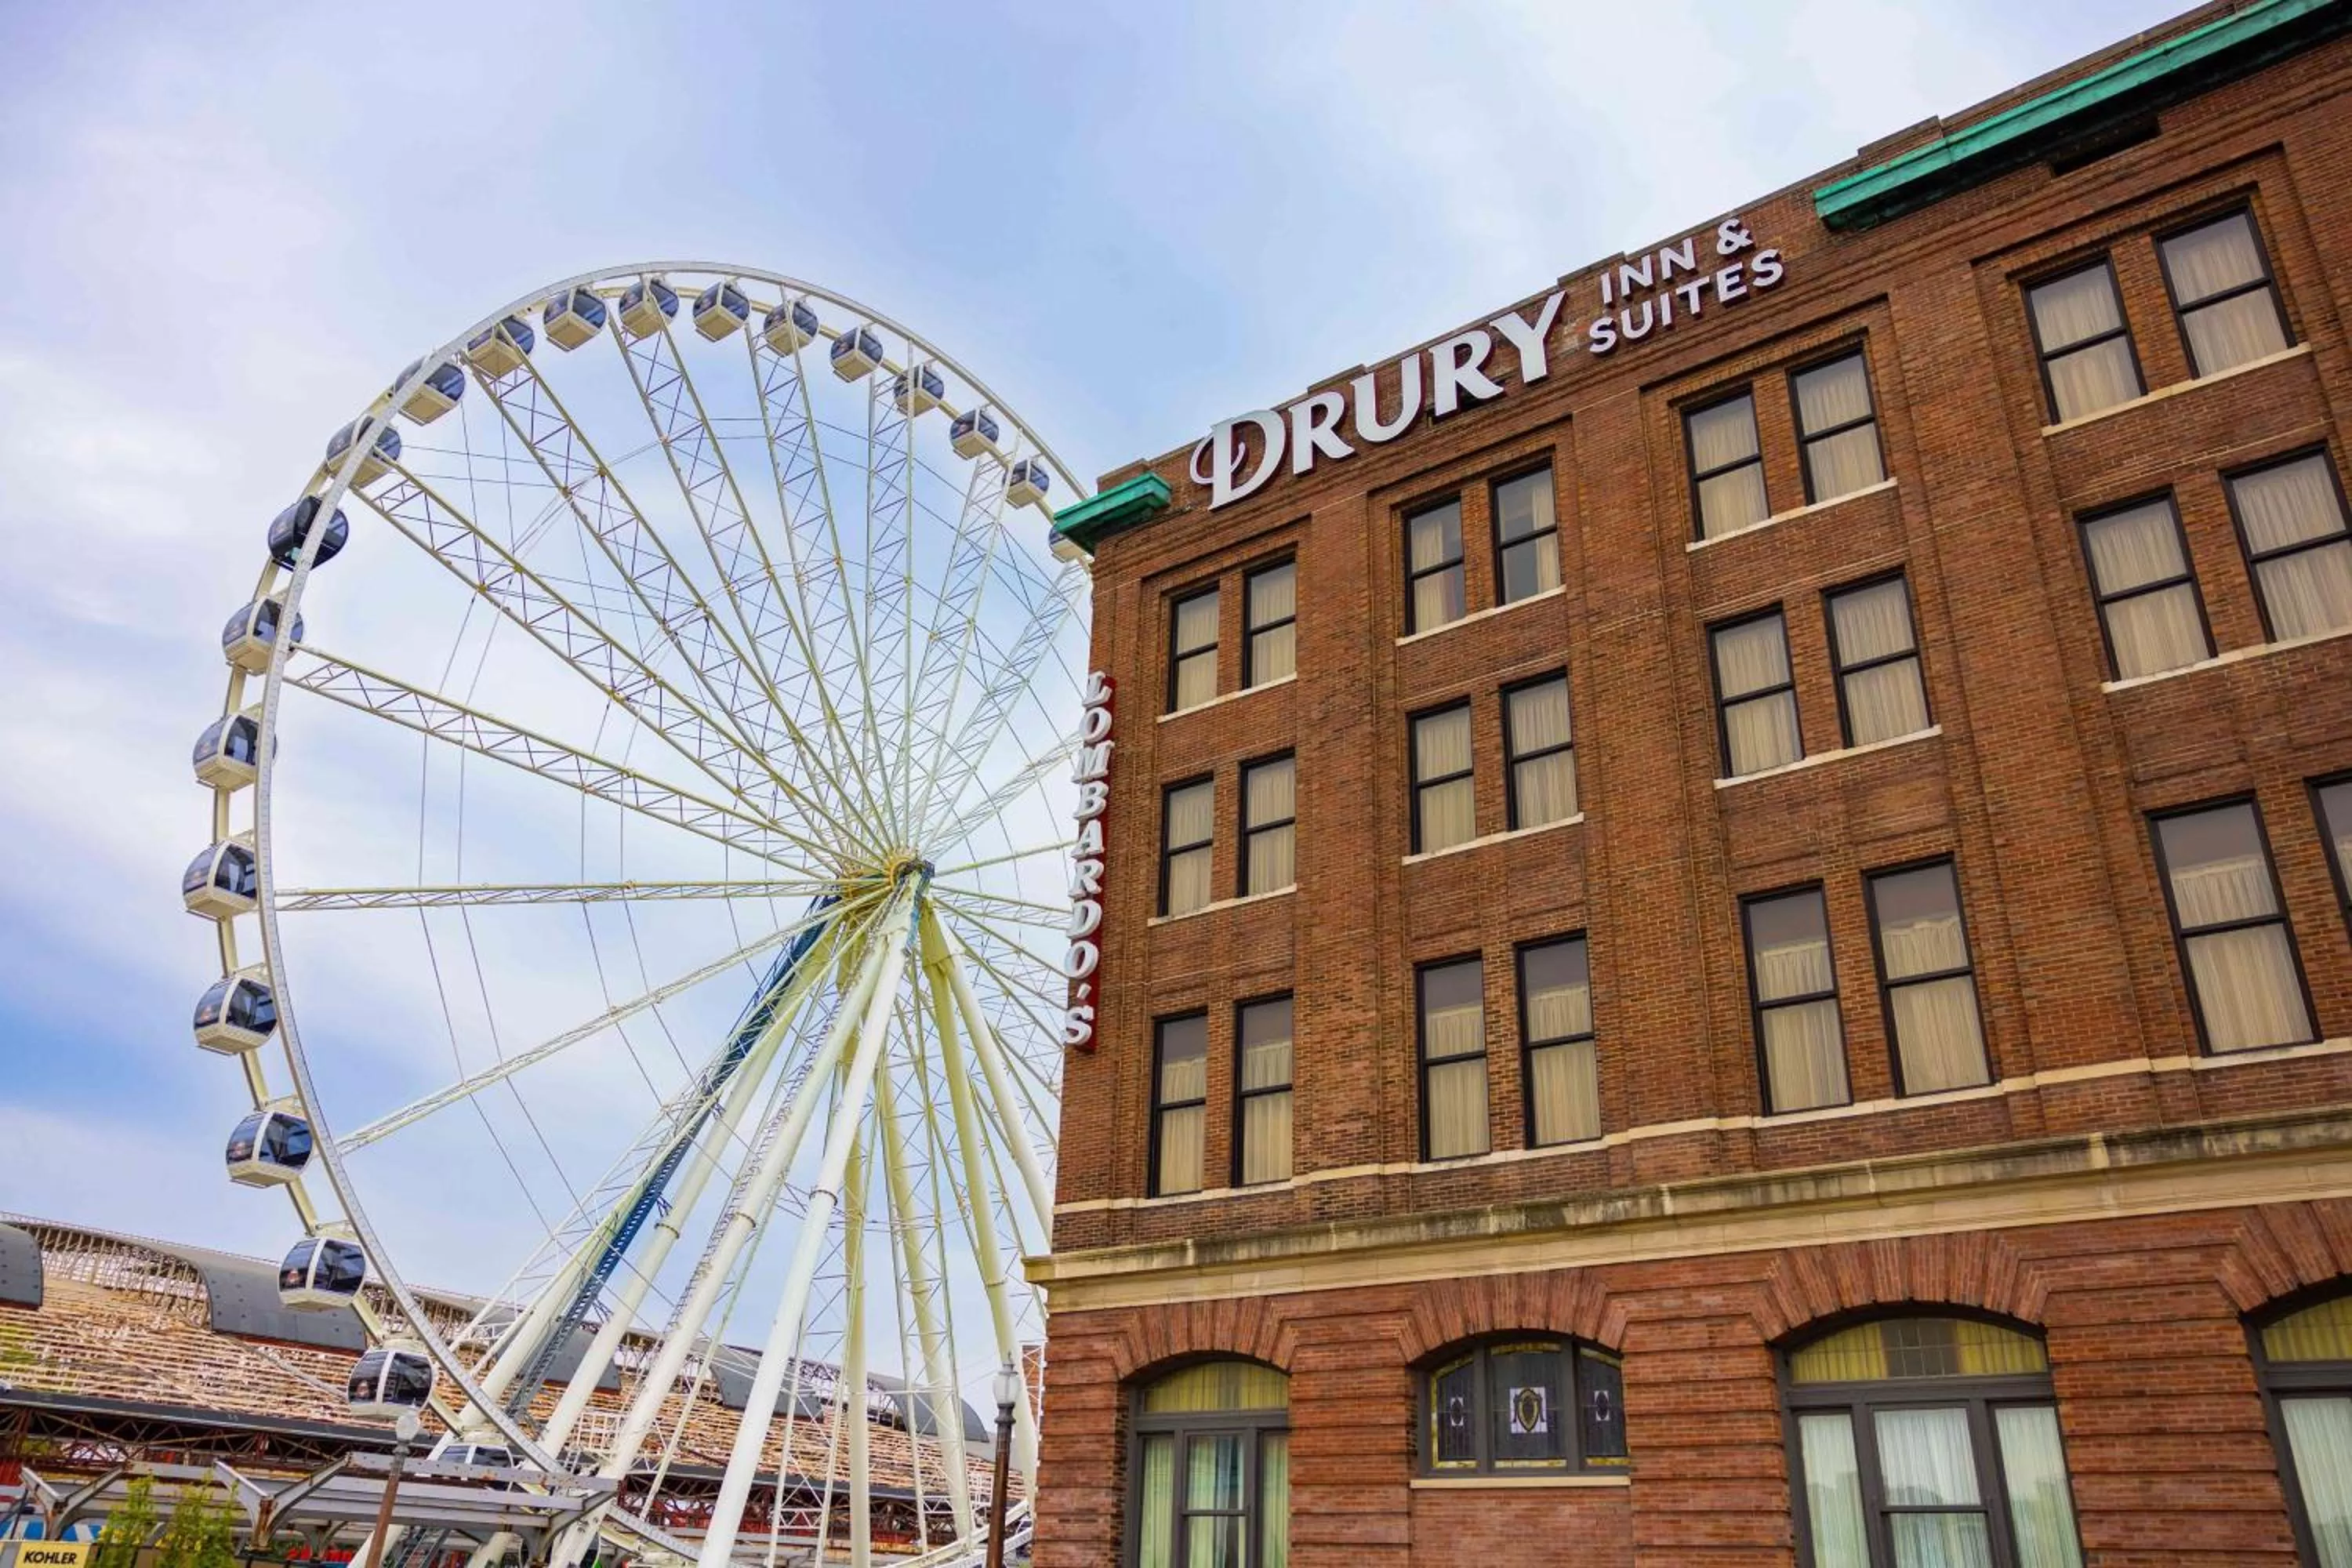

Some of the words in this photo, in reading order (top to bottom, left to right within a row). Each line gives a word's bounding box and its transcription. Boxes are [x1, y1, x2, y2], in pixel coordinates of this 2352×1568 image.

[1588, 248, 1784, 354] SUITES
[1602, 236, 1697, 307] INN
[1716, 217, 1754, 255] &
[1189, 290, 1566, 511] DRURY
[1063, 670, 1115, 1046] LOMBARDO'S
[24, 1552, 77, 1564] KOHLER
